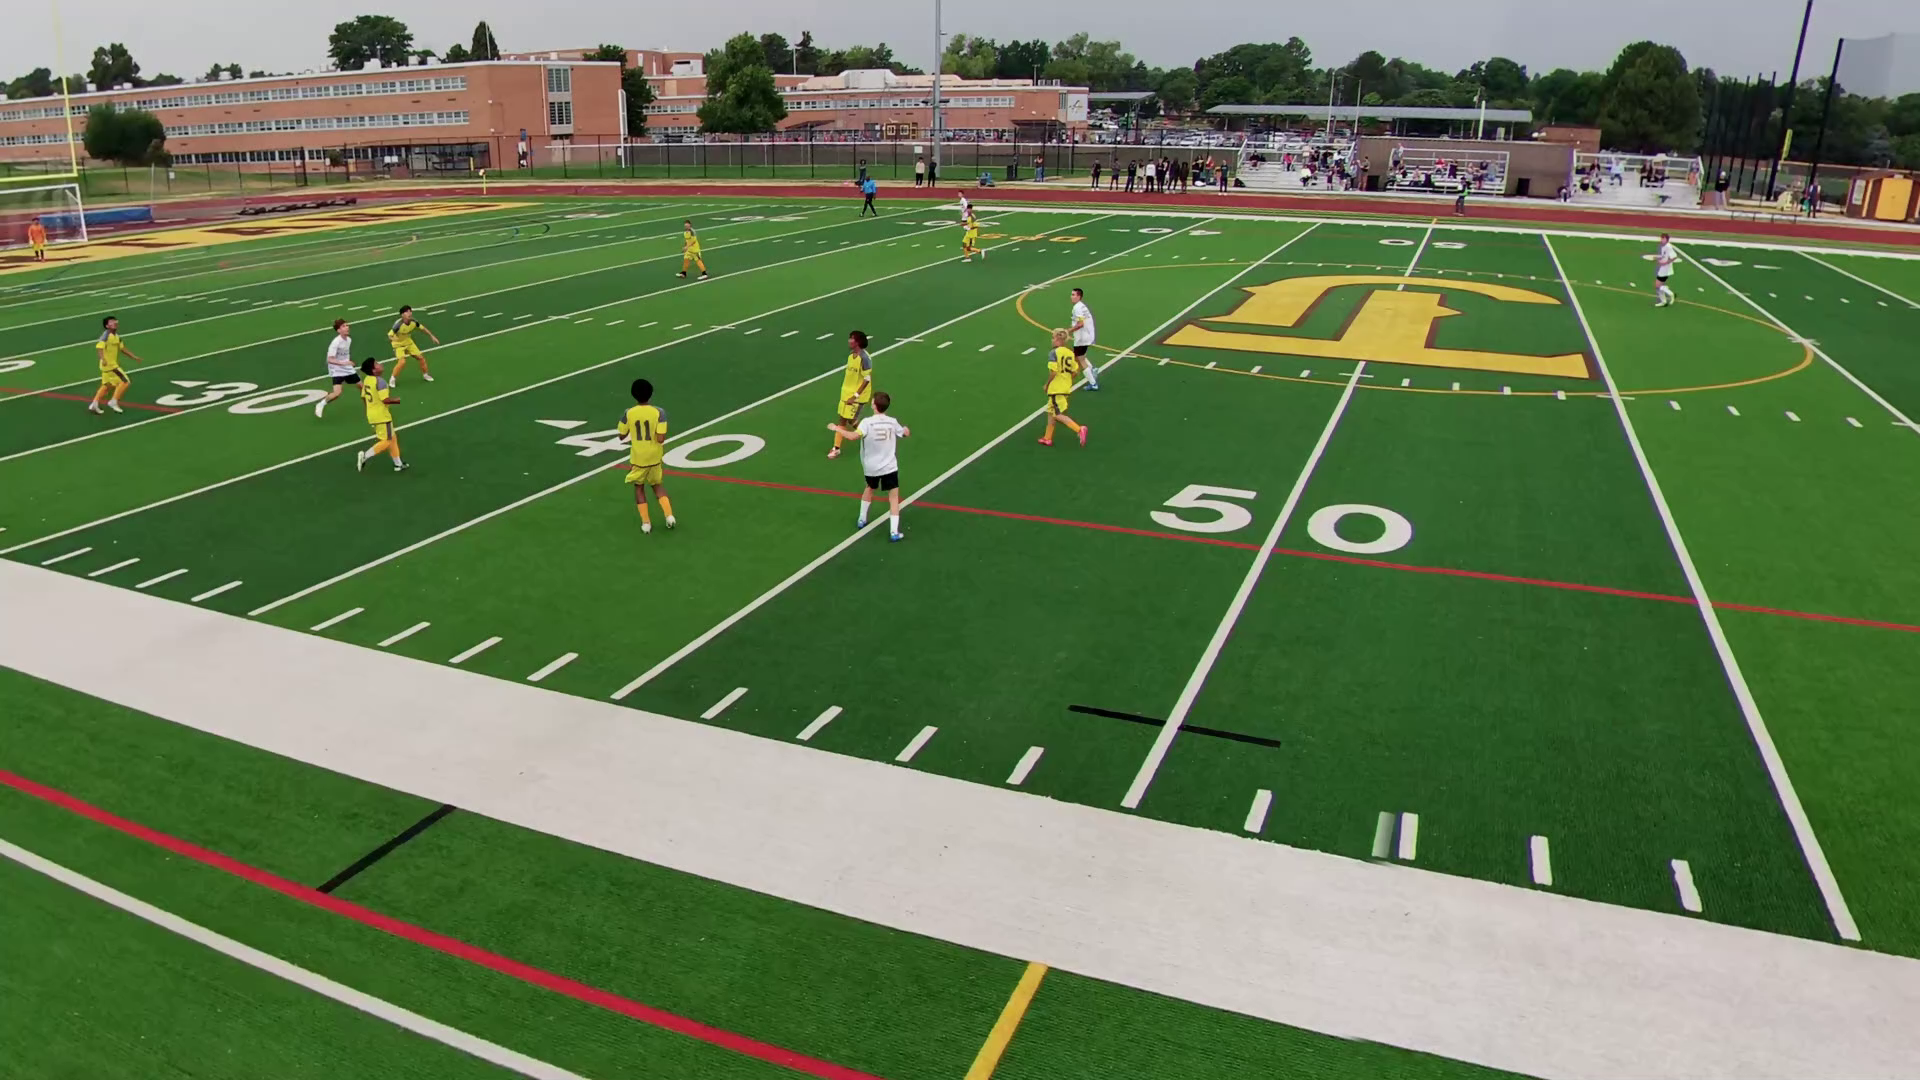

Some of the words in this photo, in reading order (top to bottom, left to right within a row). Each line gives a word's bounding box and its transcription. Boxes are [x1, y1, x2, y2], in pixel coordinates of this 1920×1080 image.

[156, 381, 328, 415] 30
[635, 420, 652, 441] 11
[873, 427, 893, 441] 31
[555, 429, 765, 468] 40
[1150, 484, 1412, 554] 50
